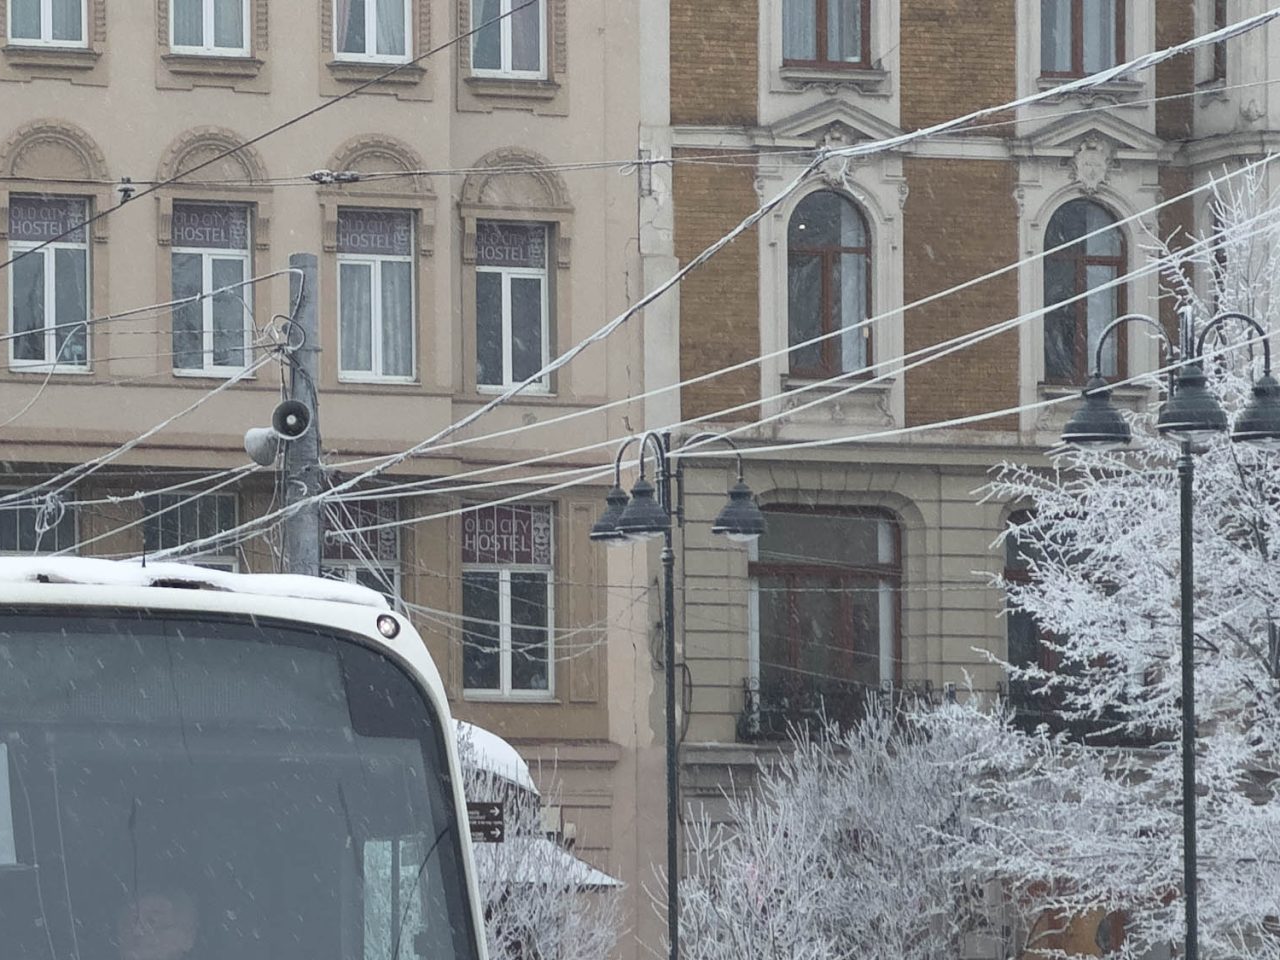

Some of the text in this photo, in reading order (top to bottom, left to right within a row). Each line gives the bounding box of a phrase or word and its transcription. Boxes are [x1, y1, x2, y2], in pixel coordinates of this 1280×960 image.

[11, 206, 66, 221] OLD CITY
[11, 220, 66, 236] HOSTEL
[174, 226, 228, 242] HOSTEL
[367, 219, 393, 234] CITY
[340, 232, 393, 249] HOSTEL
[464, 533, 531, 552] HOSTEL
